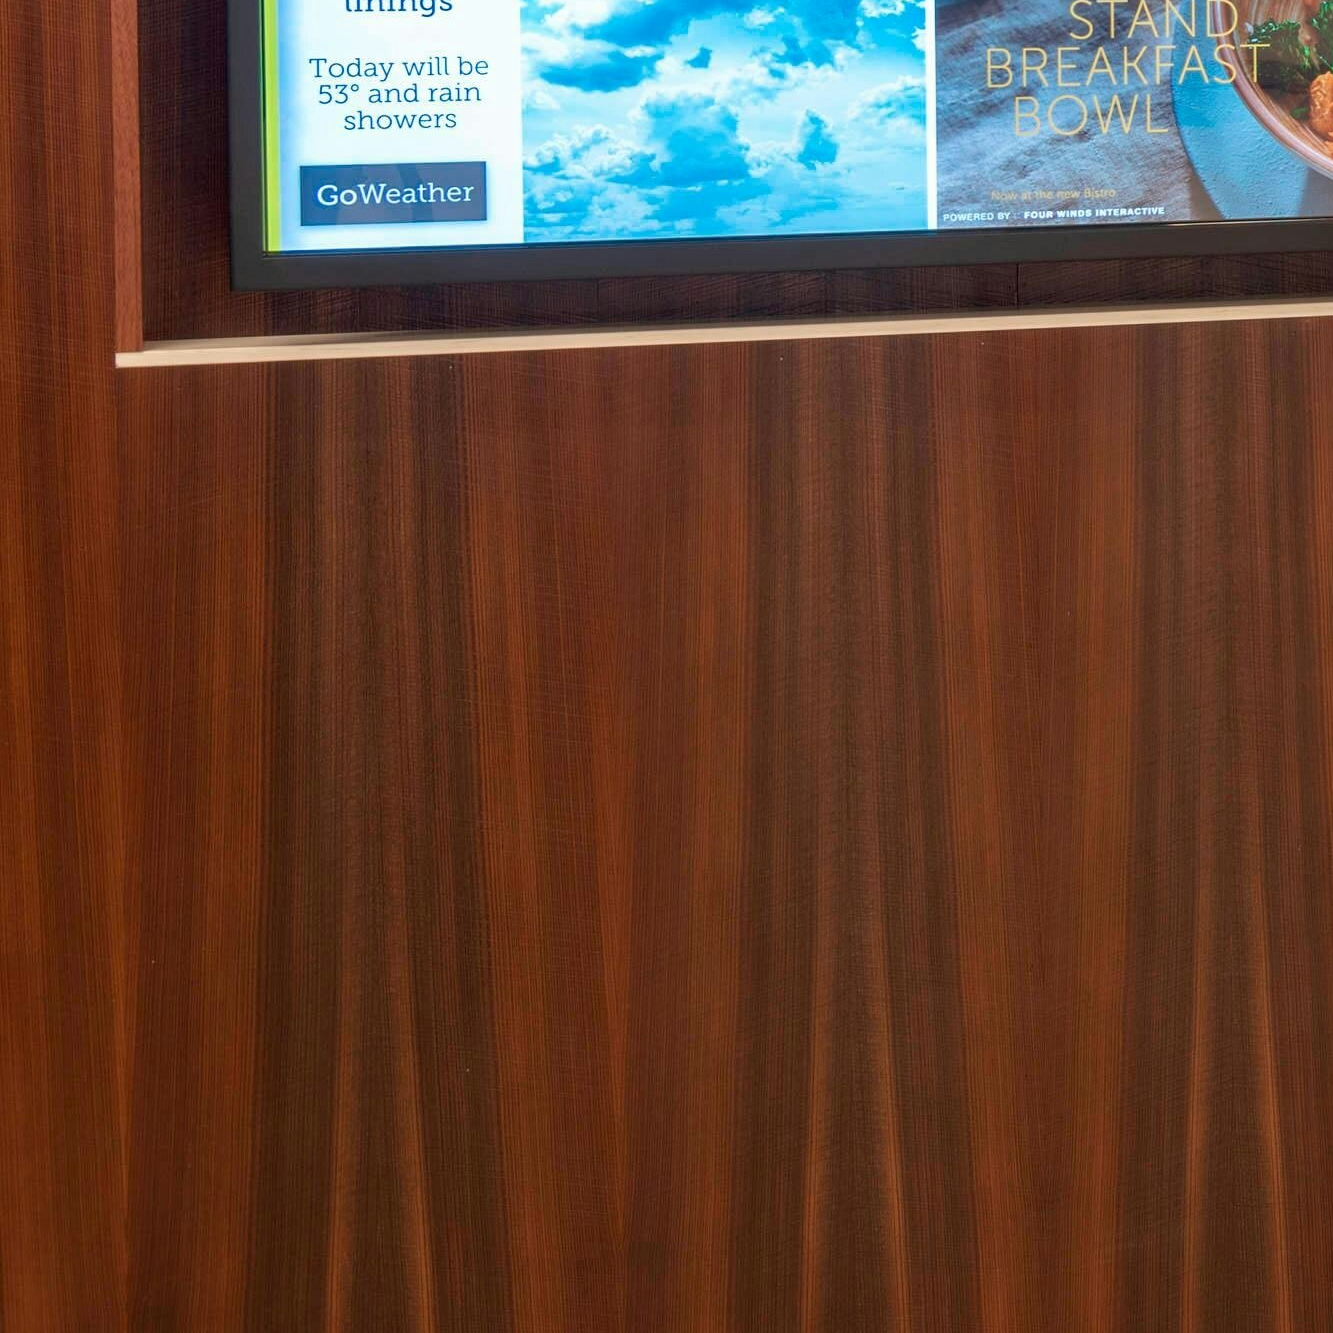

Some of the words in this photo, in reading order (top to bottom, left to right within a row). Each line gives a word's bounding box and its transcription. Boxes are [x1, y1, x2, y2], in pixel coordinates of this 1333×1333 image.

[309, 57, 395, 80] Today
[402, 56, 450, 77] will
[458, 55, 489, 77] be
[986, 43, 1271, 89] BREAKFAST
[318, 83, 360, 105] 53°
[368, 83, 419, 104] and
[427, 82, 482, 103] rain
[343, 109, 457, 131] showers
[1014, 93, 1169, 137] BOWL
[317, 183, 475, 207] GoWeather
[1084, 186, 1117, 199] Bistro
[943, 212, 994, 222] POWERED
[997, 211, 1011, 220] BY
[1024, 210, 1054, 220] FOUR
[1056, 208, 1092, 218] WINDS
[1095, 206, 1166, 217] INTERACTIVE
